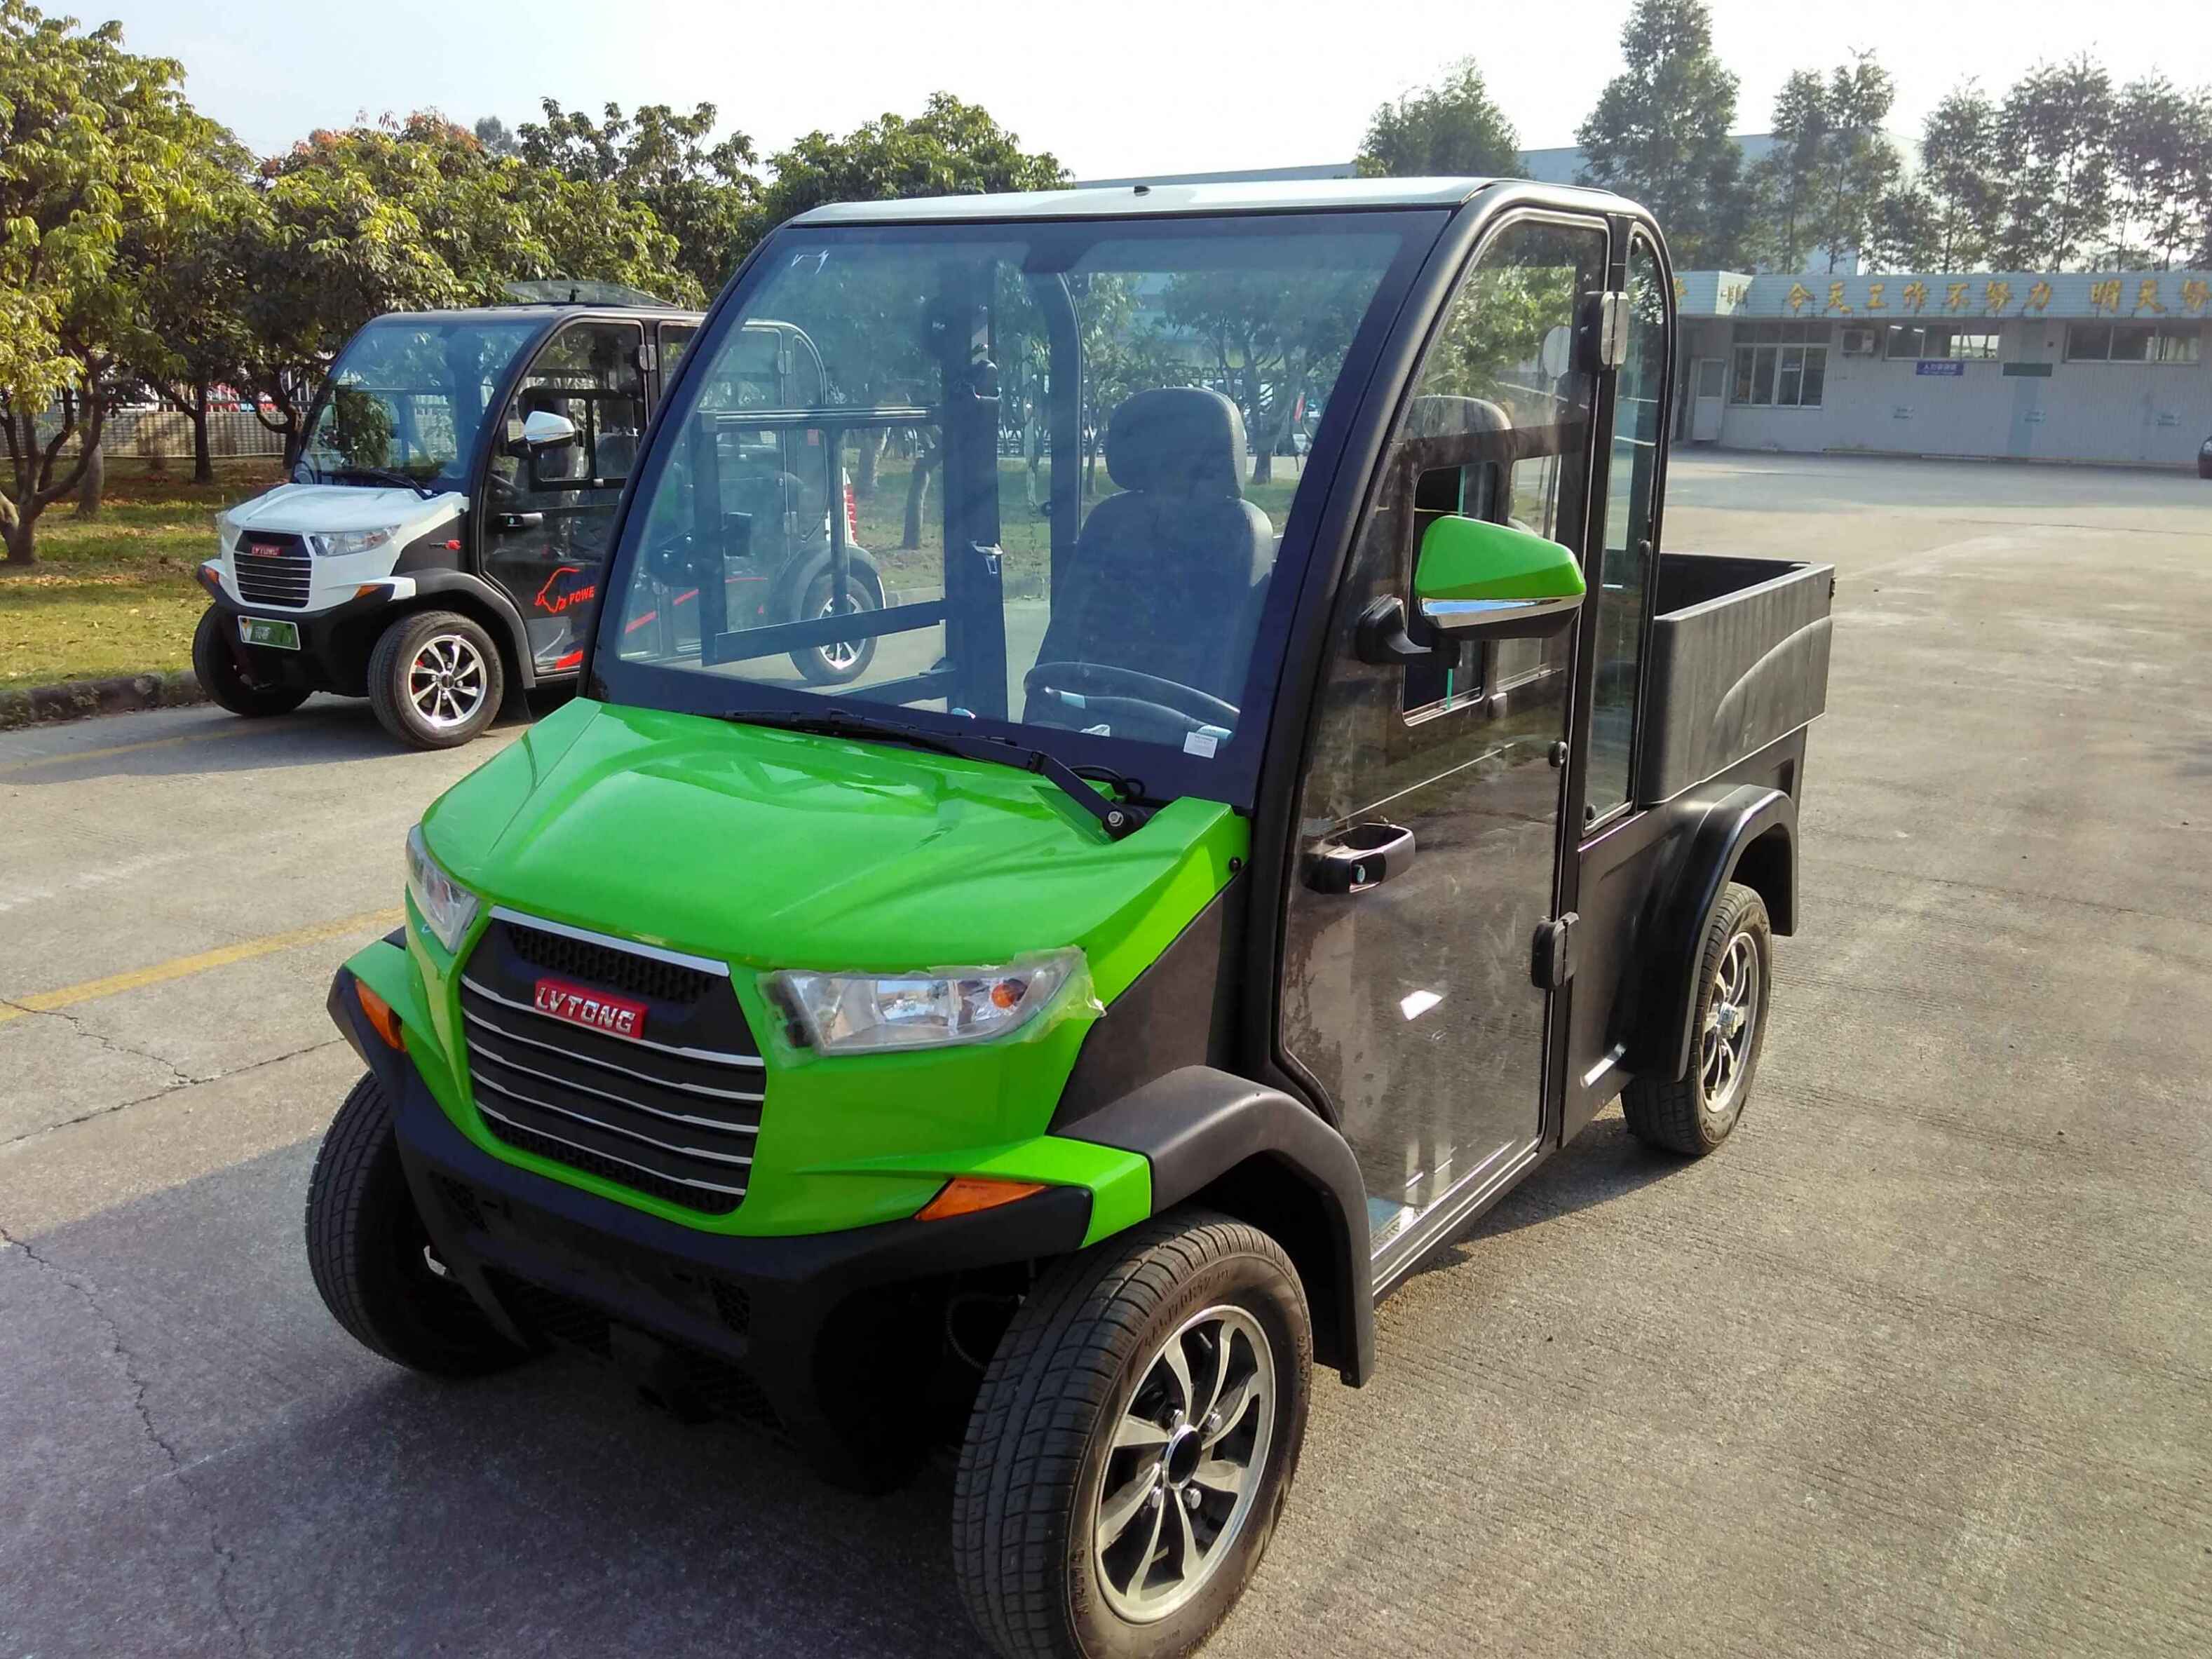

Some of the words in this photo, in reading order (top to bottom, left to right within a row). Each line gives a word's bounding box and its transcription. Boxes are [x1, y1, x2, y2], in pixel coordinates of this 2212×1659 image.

[1787, 280, 2054, 313] 今天工作不努力
[569, 586, 595, 605] POWE
[536, 987, 635, 1034] LVTONG
